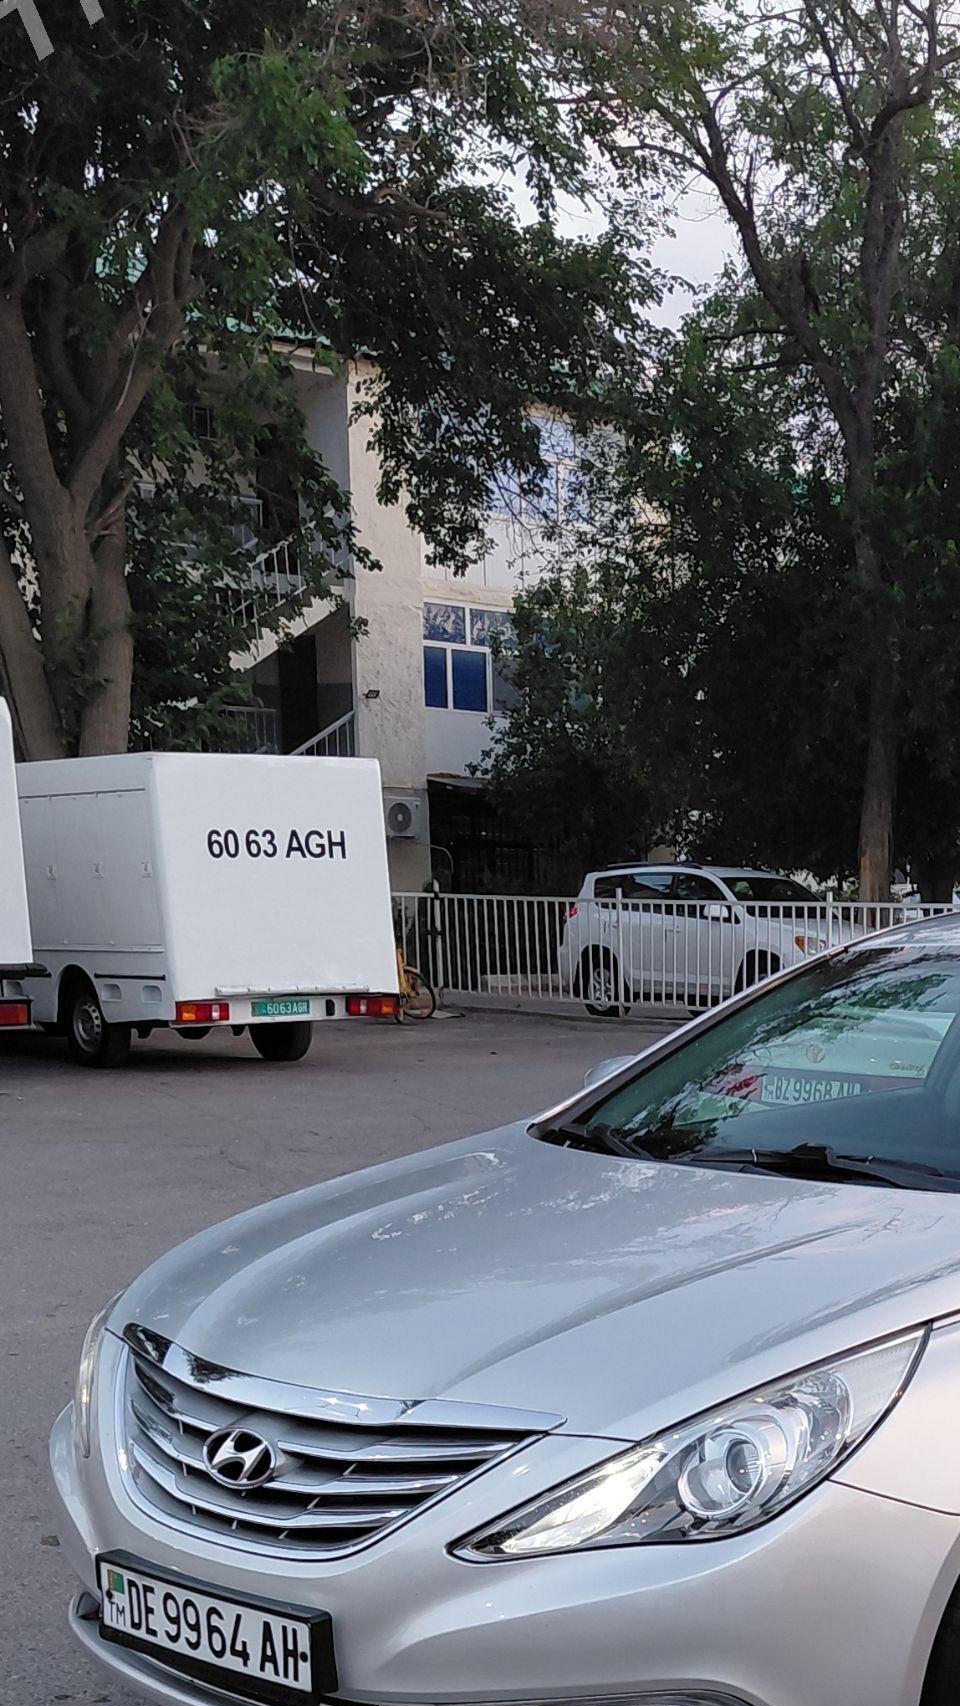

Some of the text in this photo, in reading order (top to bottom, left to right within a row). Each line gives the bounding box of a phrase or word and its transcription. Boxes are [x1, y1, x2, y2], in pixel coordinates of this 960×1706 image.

[207, 829, 347, 859] 60 63 AGH
